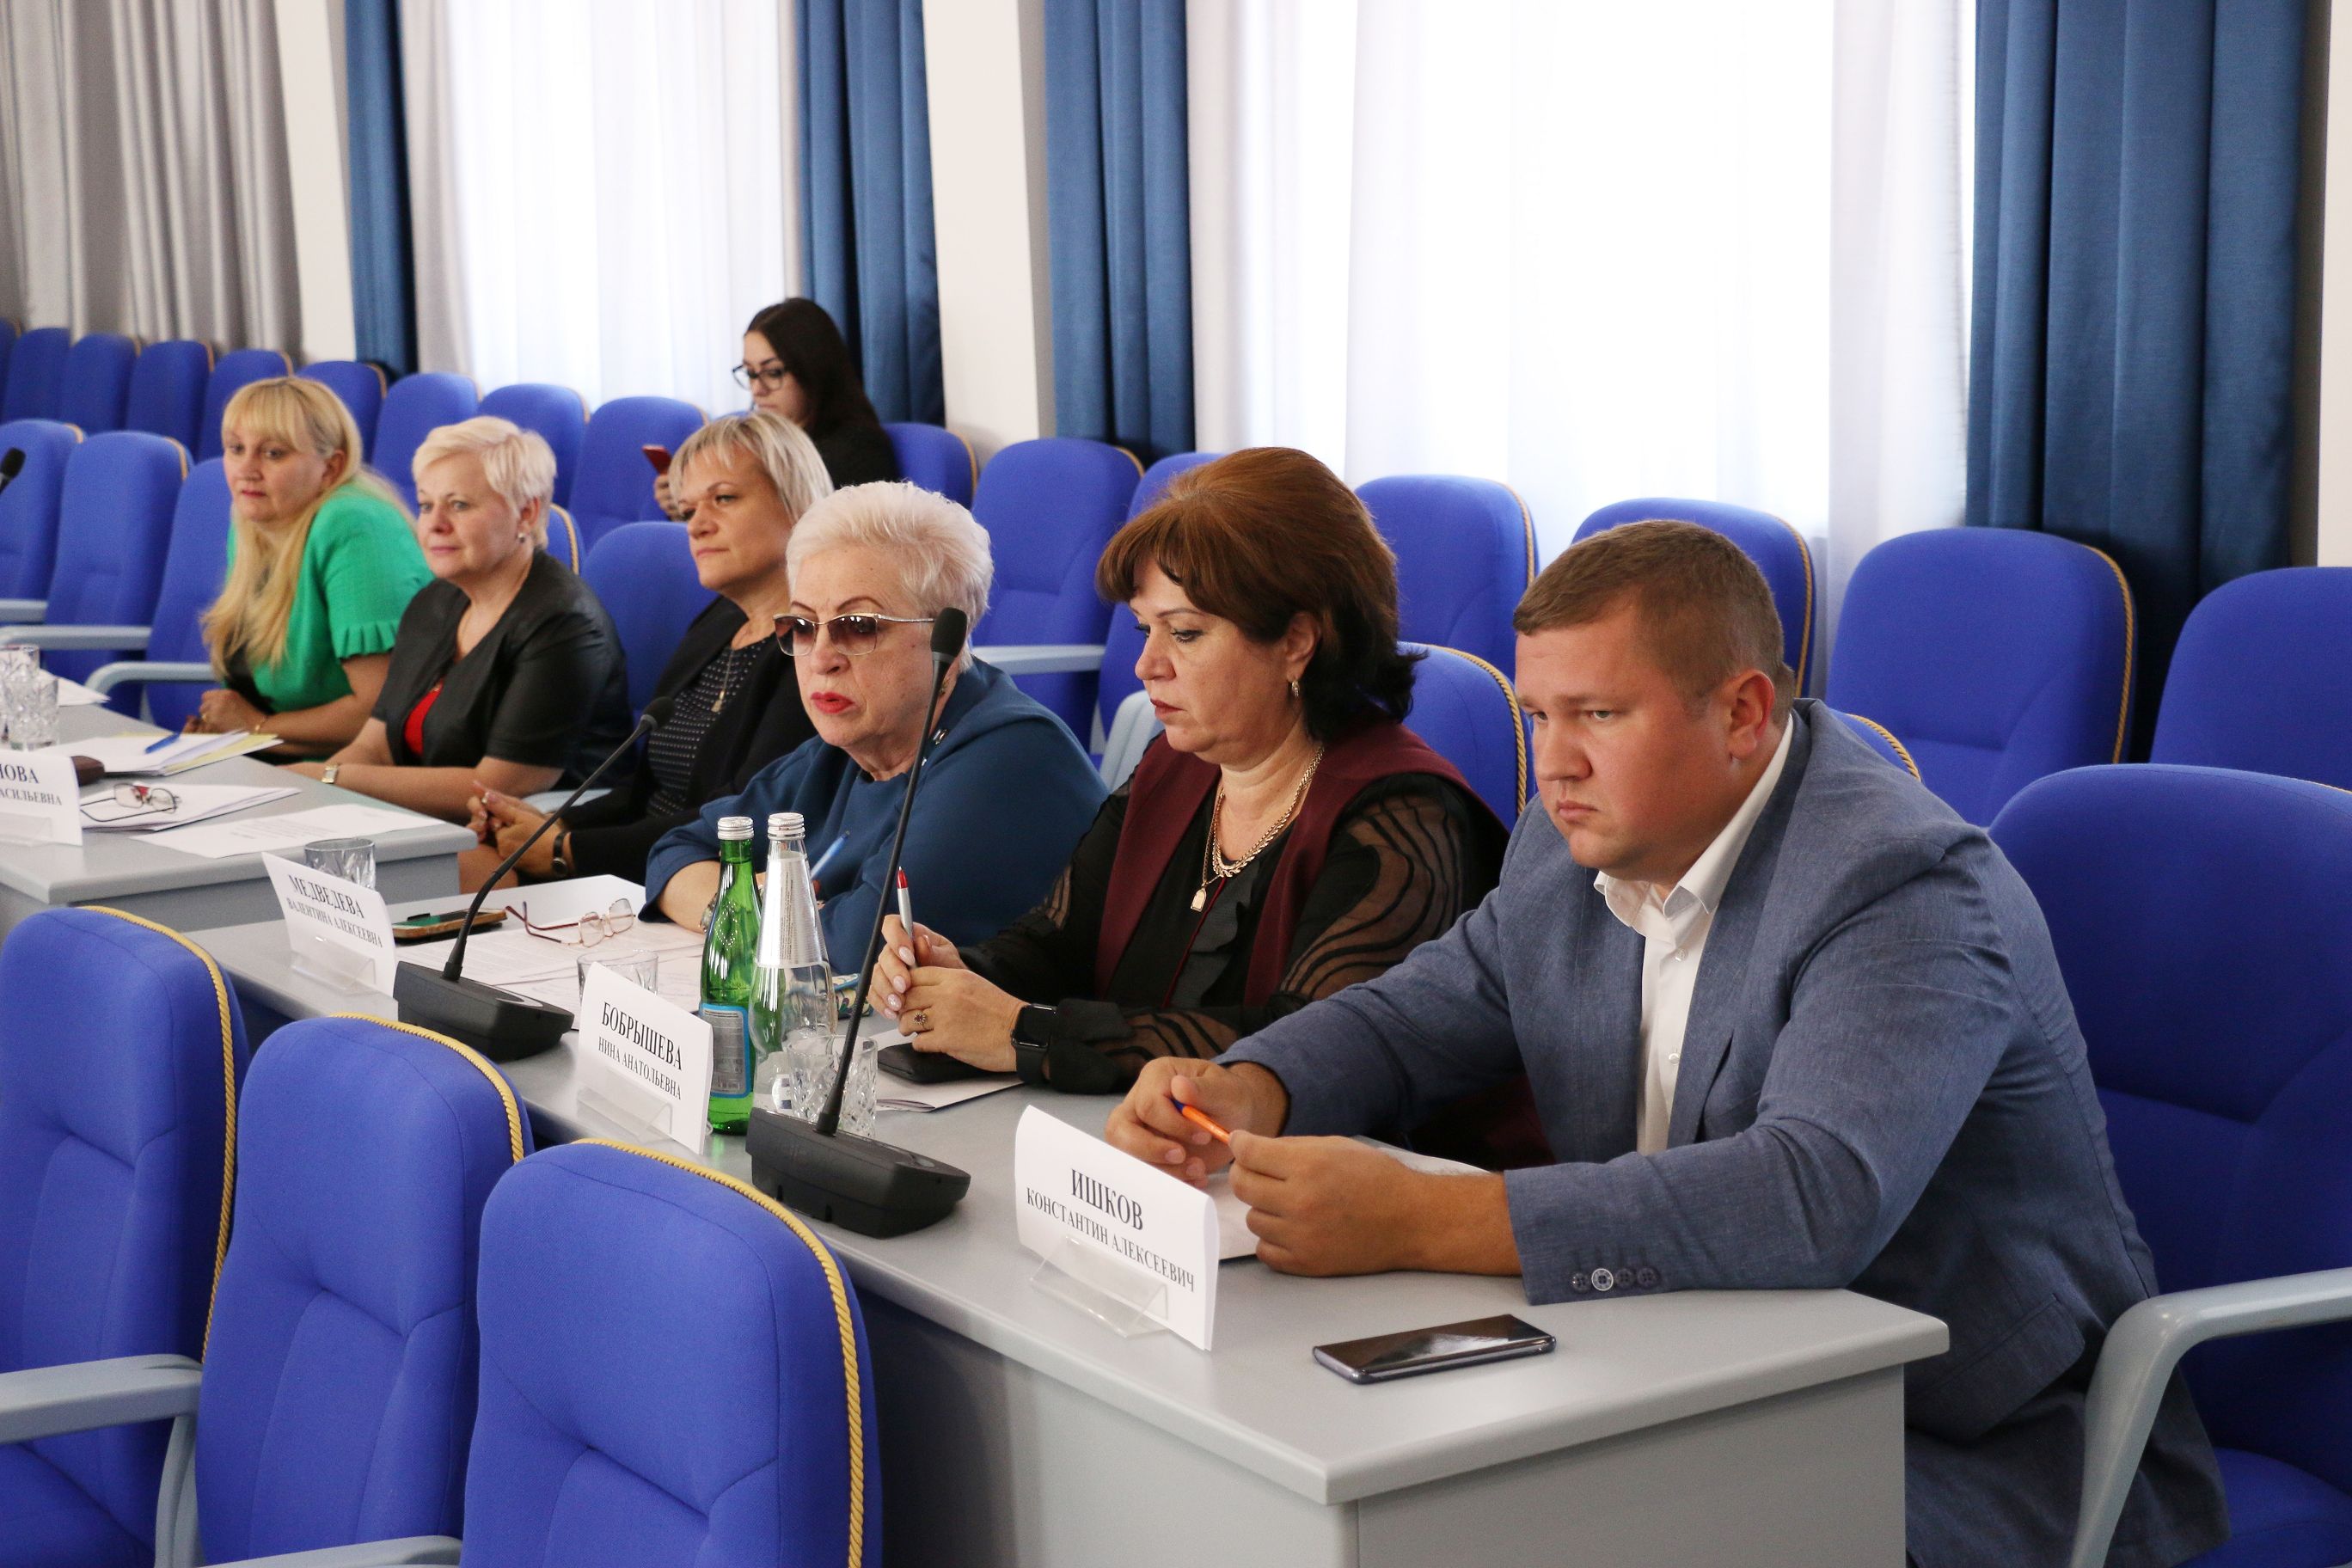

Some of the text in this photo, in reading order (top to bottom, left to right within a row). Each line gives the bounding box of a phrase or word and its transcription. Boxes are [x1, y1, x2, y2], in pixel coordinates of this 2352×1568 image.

[286, 897, 383, 948] ВАЛЕНТИНА АЛЕКСЕЕВНА
[288, 874, 364, 919] МЕДВЕДЕВА
[598, 1036, 621, 1063] НИНА
[622, 1051, 682, 1101] АНАТОЛЬЕВНА
[601, 1001, 683, 1072] БОБРЫШЕВА
[1070, 1167, 1144, 1231] ИШКОВ
[1026, 1186, 1195, 1293] КОНСТАНТИН АЛЕКСЕЕВИЧ
